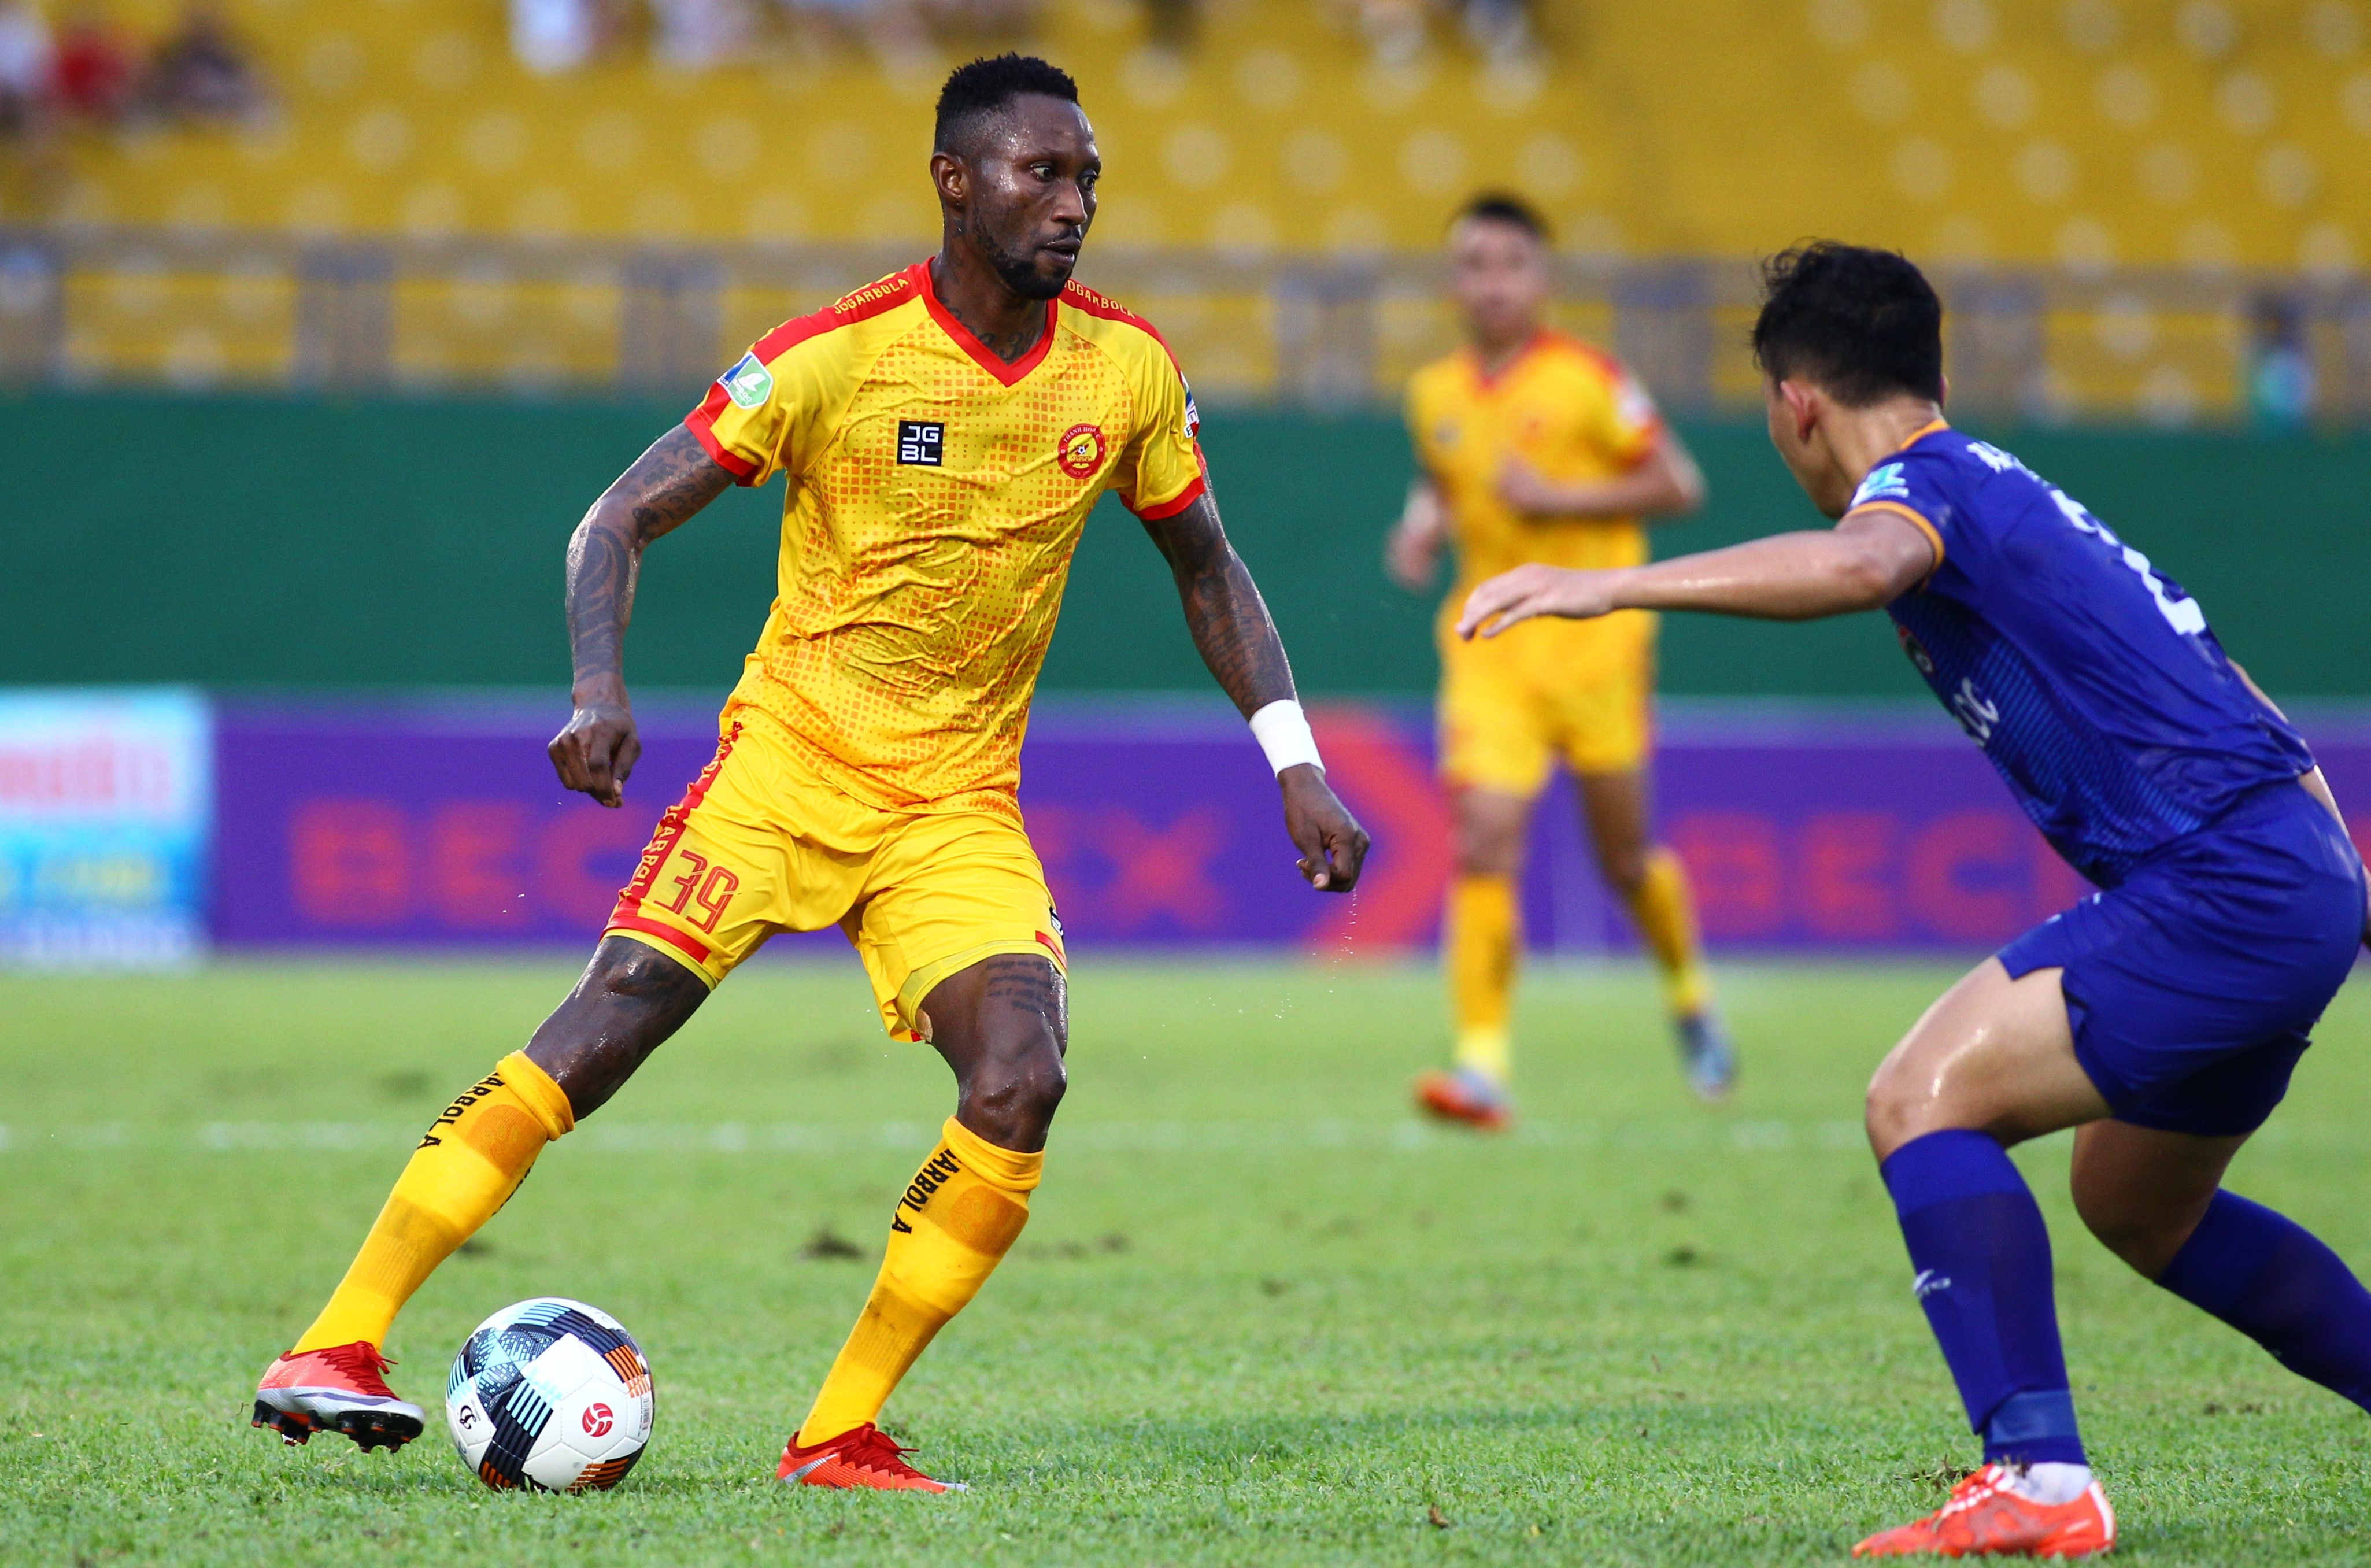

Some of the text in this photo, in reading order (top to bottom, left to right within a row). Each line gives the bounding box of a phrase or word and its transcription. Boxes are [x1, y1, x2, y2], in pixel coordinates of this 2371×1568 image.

[834, 279, 909, 314] JOGARBOLA
[1064, 280, 1135, 319] OGARBOLA
[902, 425, 939, 443] JG
[901, 444, 938, 462] BL
[654, 849, 739, 934] 39
[416, 1072, 505, 1150] ARBOLA
